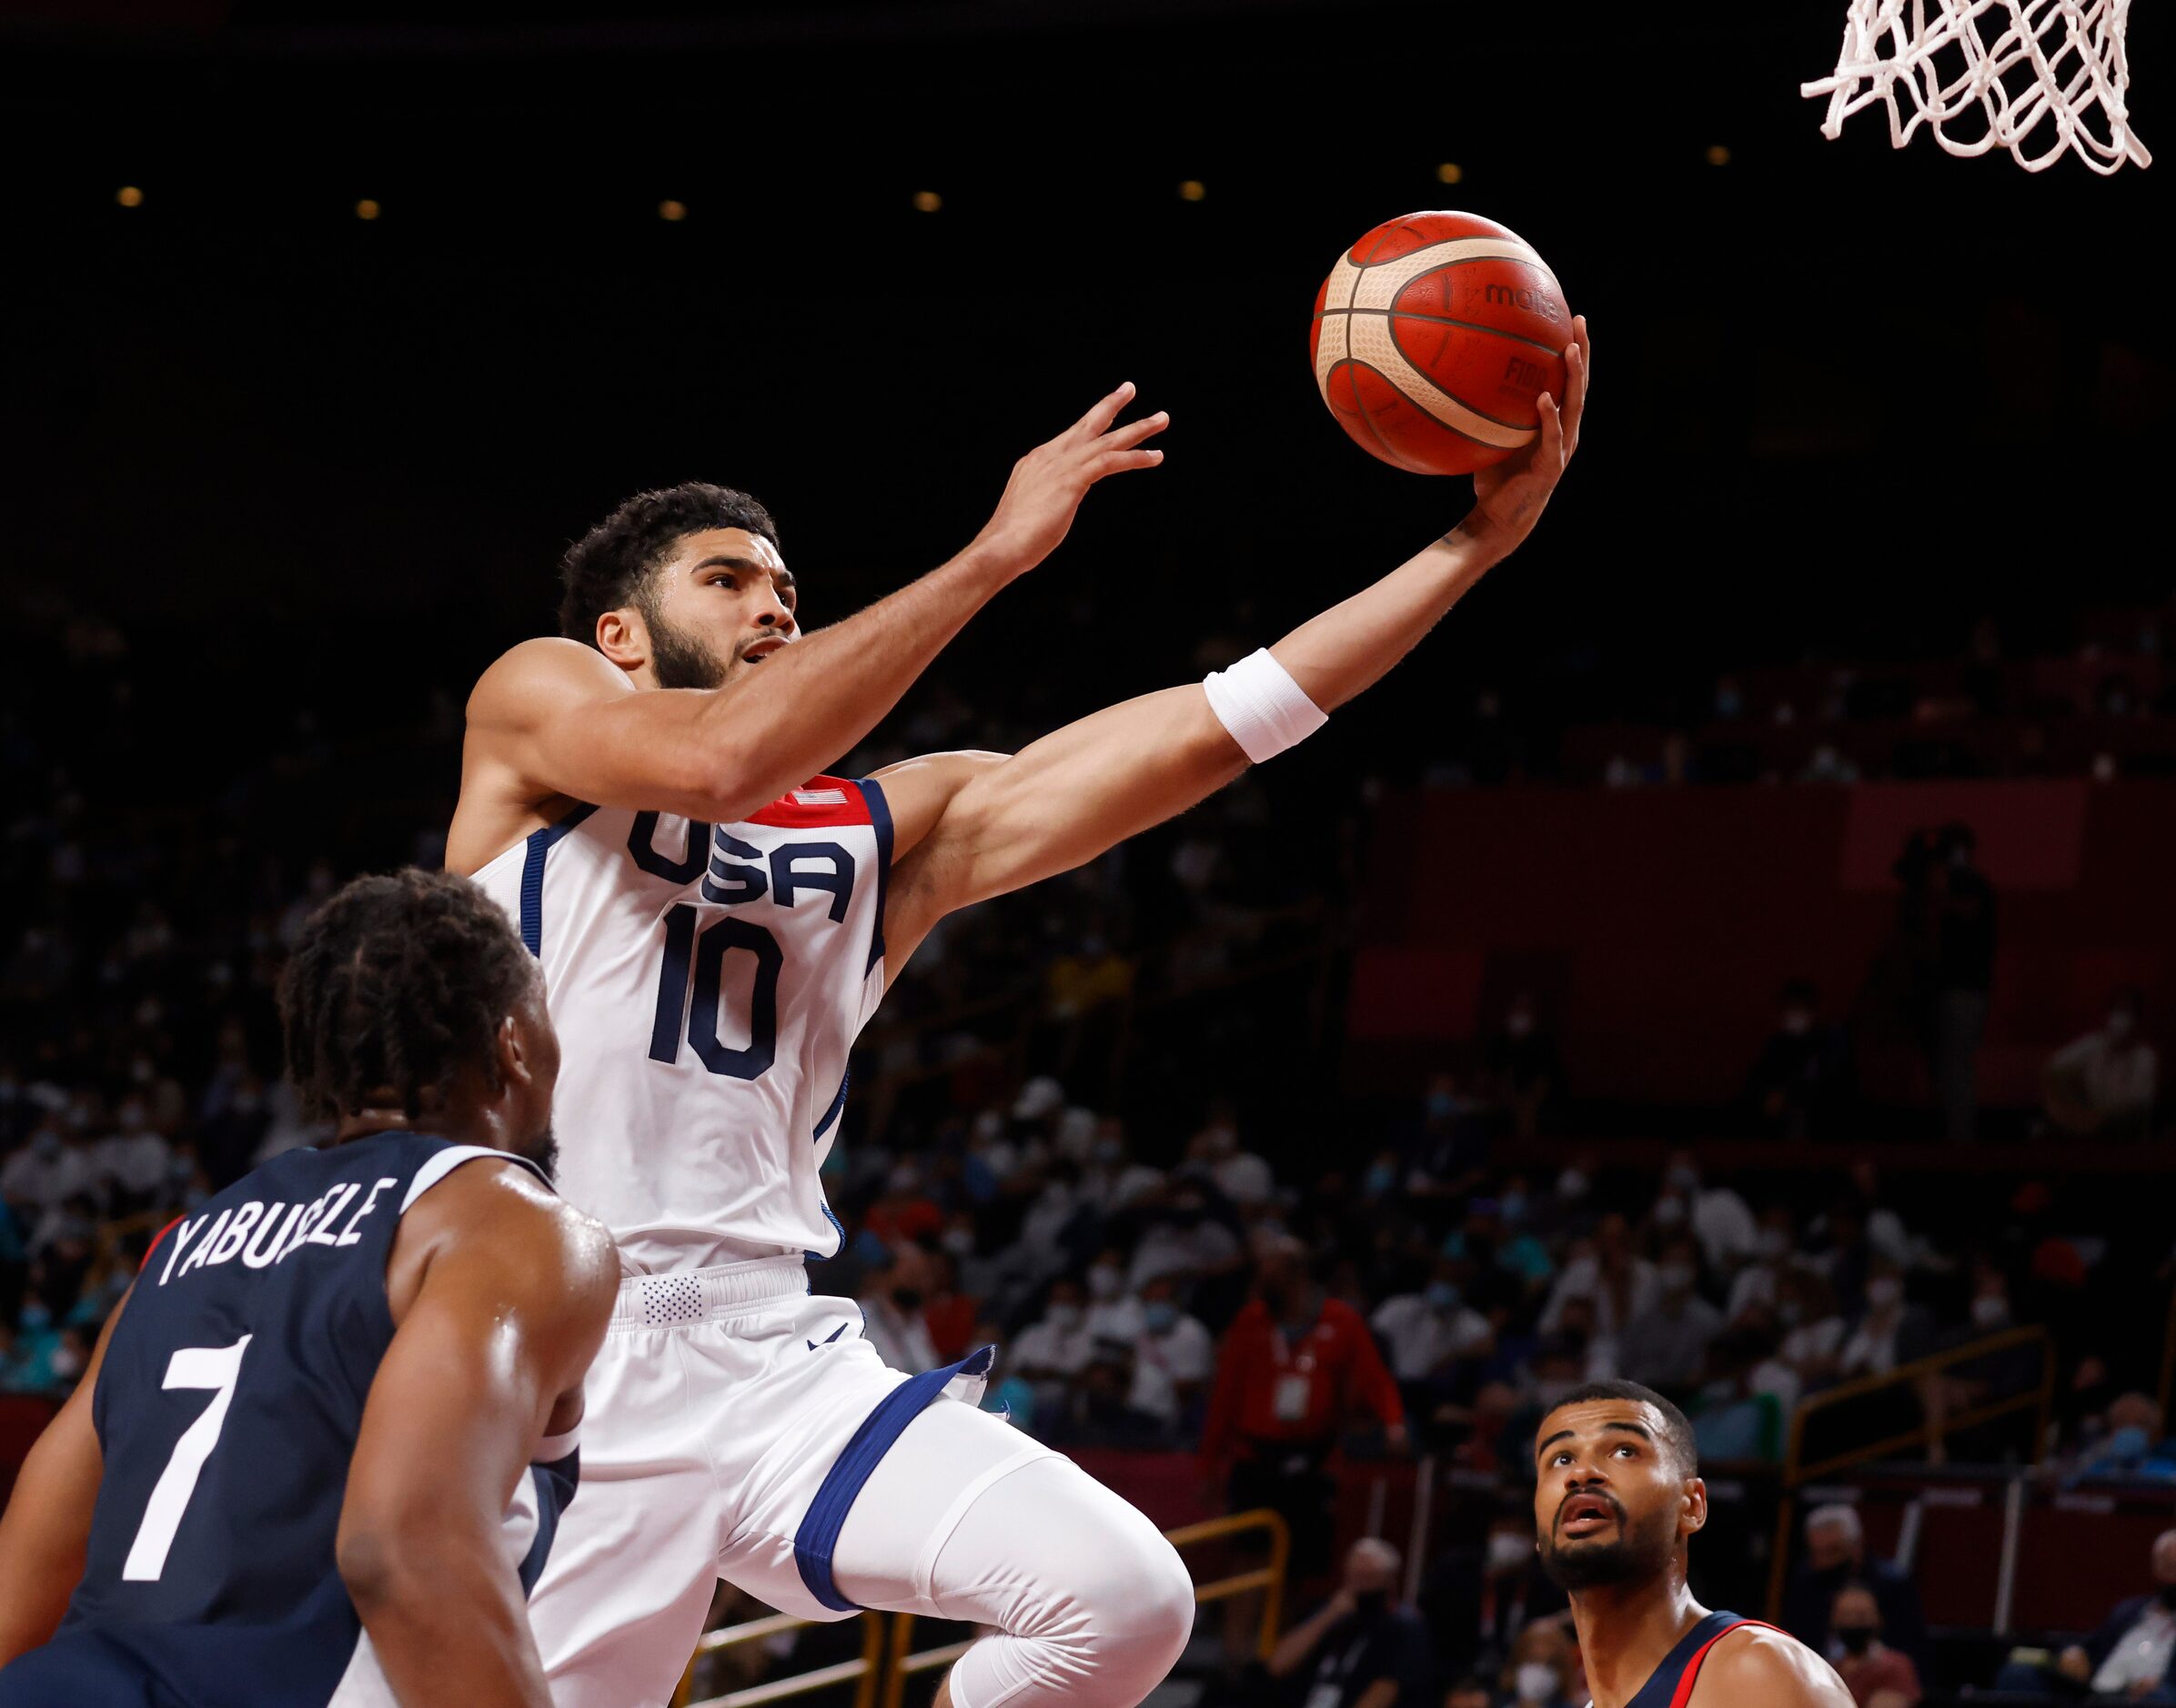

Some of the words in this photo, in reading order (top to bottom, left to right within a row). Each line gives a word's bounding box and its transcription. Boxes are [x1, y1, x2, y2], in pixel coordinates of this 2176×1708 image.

[627, 809, 856, 924] USA
[648, 902, 784, 1080] 10
[122, 1333, 254, 1582] 7
